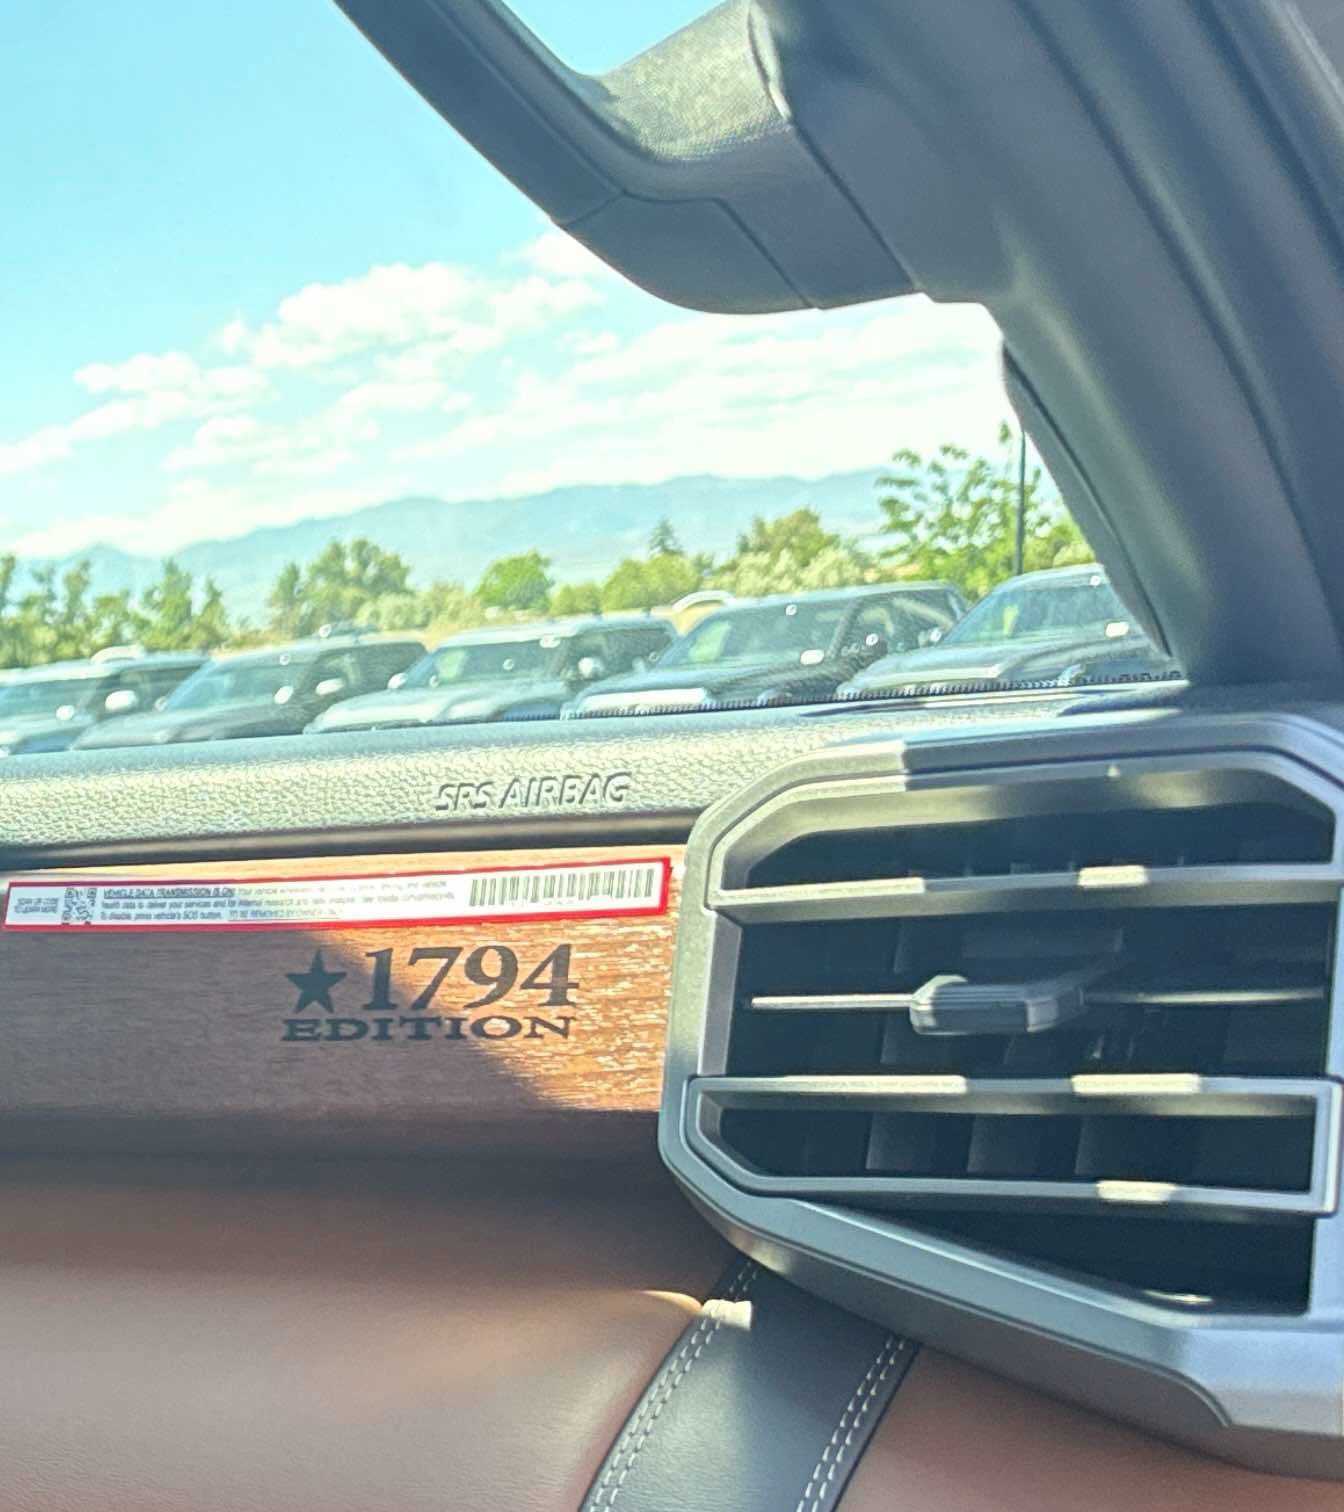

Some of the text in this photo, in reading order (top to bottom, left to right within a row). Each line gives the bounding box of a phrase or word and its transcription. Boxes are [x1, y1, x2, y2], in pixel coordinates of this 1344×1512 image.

[435, 771, 632, 811] SRS AIRBAG
[364, 943, 580, 1011] 1794
[280, 1015, 578, 1042] EDITION
